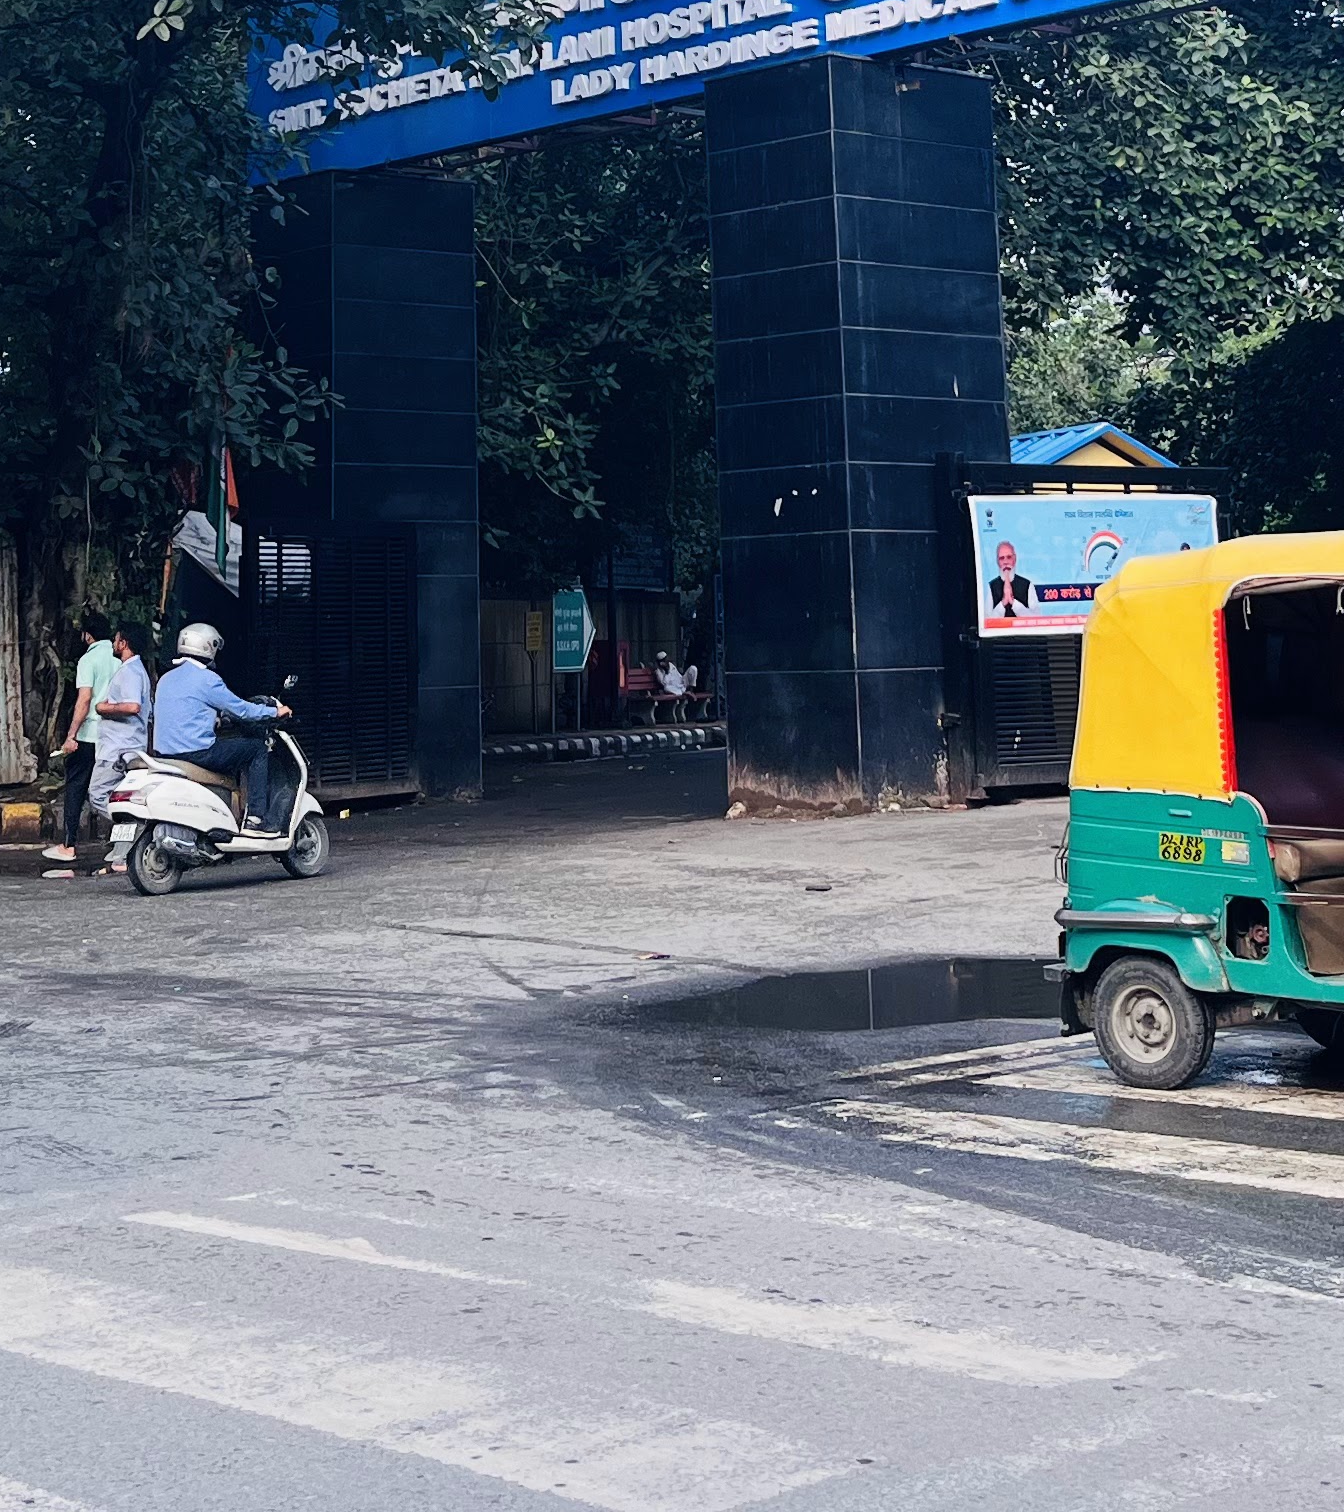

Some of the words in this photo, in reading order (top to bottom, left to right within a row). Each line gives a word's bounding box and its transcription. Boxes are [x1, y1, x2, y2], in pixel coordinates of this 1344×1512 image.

[551, 62, 636, 105] LADY
[639, 18, 820, 85] HARDINGE
[1043, 589, 1059, 601] 200
[1162, 845, 1202, 862] 6898
